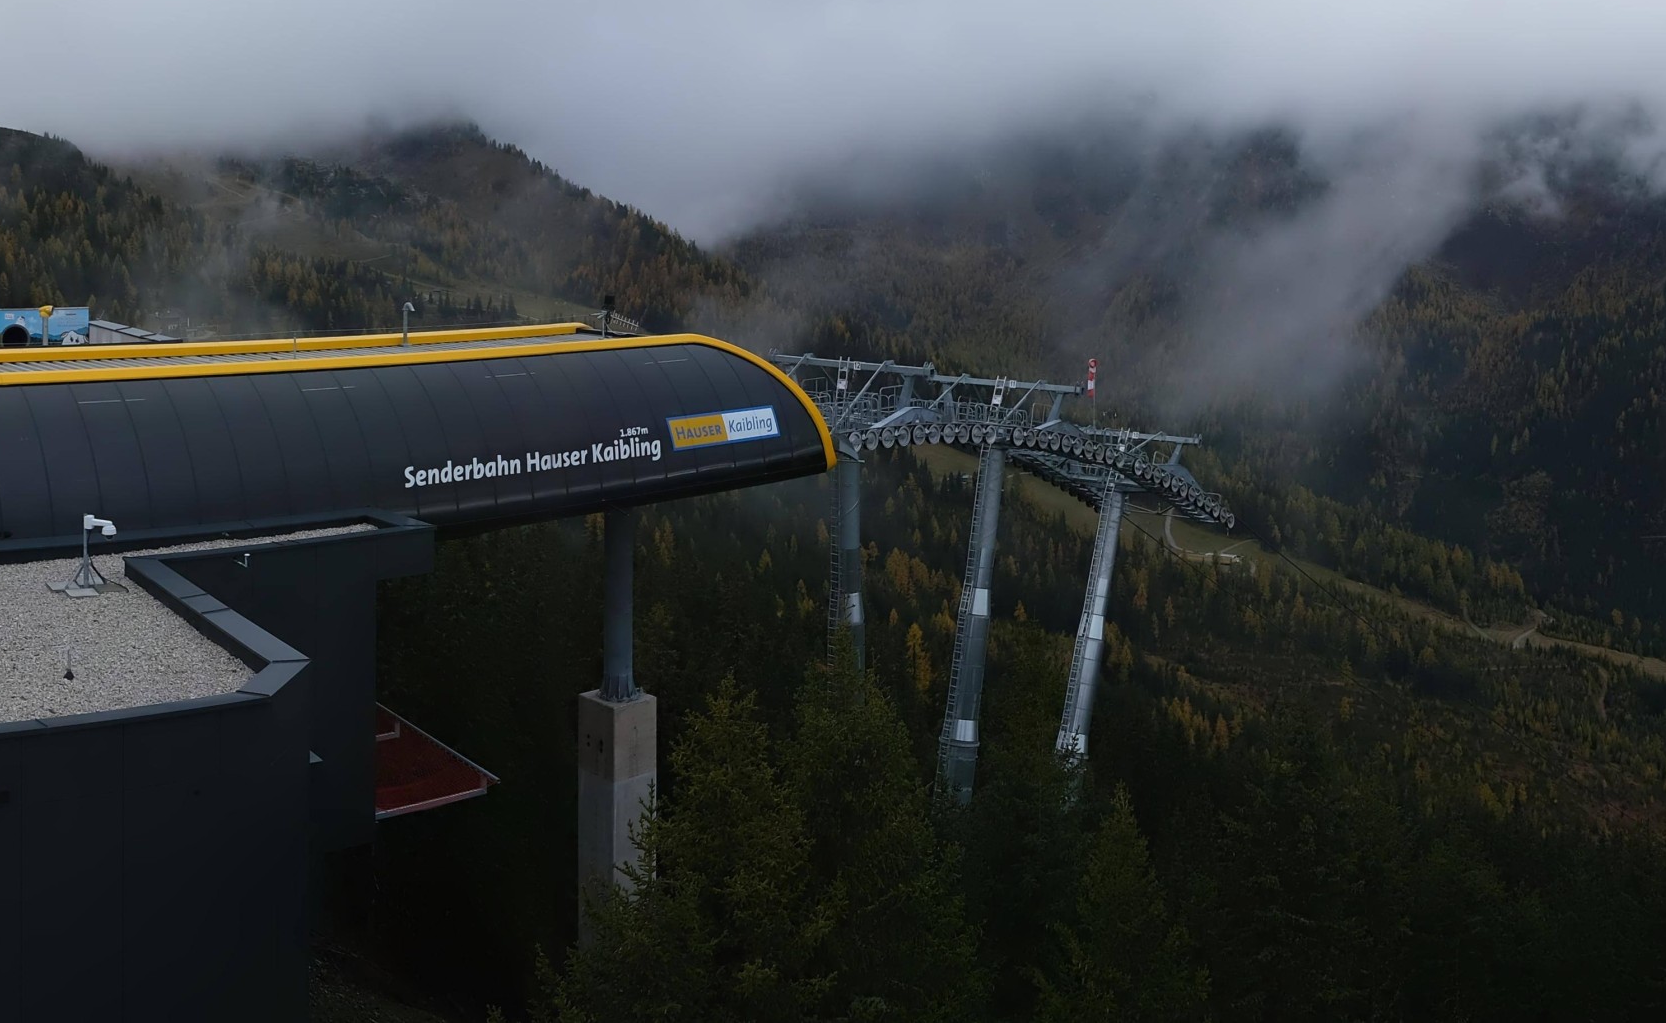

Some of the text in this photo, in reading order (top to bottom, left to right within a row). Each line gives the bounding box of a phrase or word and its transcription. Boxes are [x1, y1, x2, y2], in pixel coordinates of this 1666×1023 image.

[620, 426, 649, 438] 1.867m
[674, 416, 773, 440] HAUSER Kaibling
[404, 437, 662, 488] Senderbahn Hauser Kaibling
